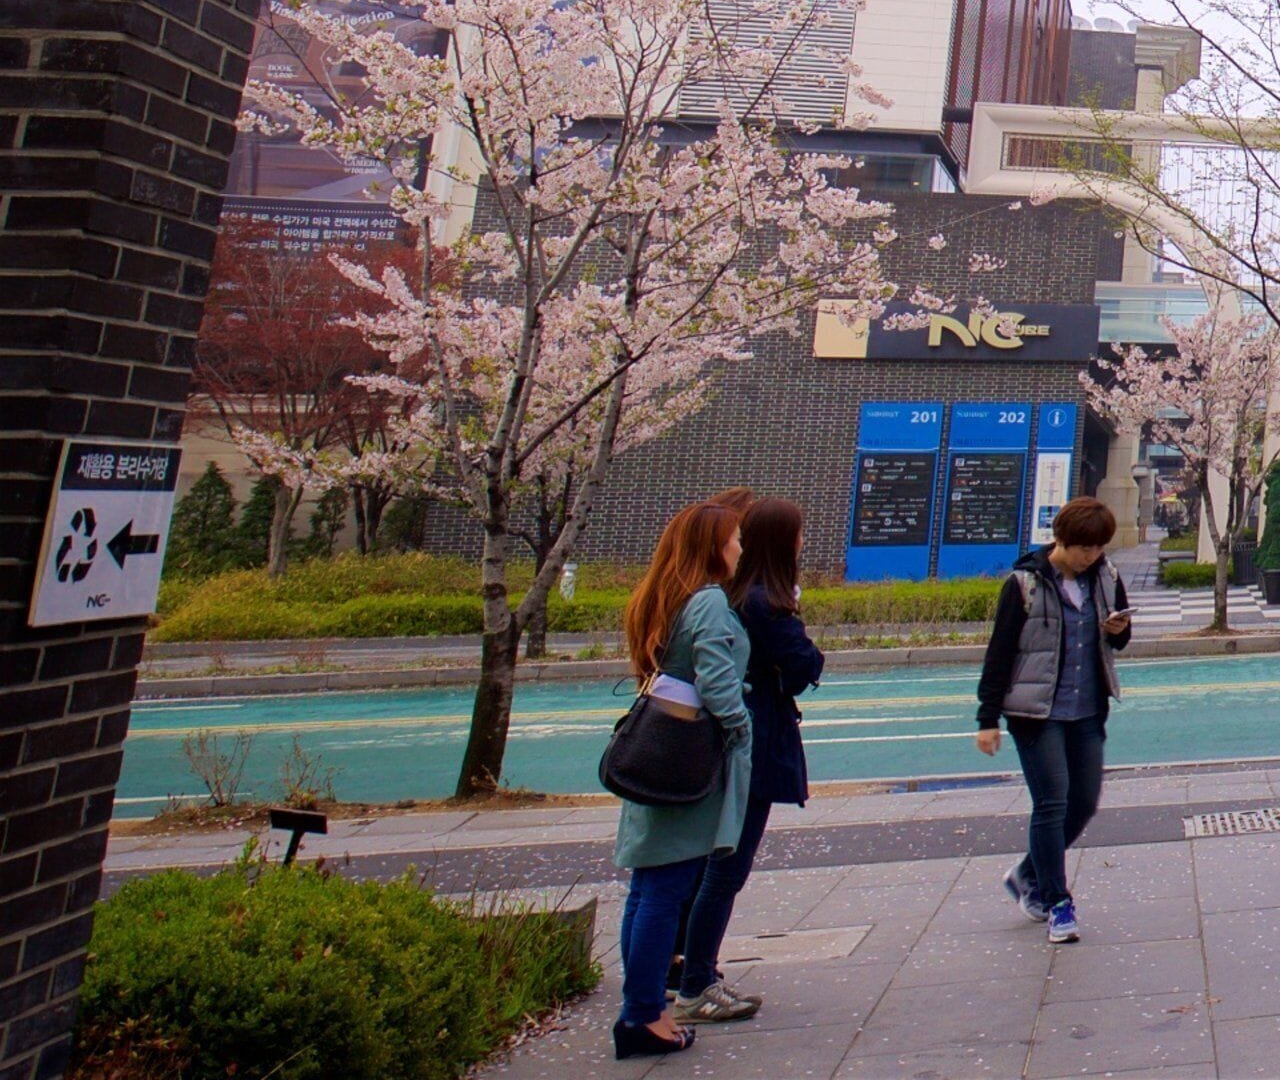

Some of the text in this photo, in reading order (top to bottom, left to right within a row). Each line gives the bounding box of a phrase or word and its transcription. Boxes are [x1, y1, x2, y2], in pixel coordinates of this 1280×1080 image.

[928, 311, 1026, 349] NC
[911, 411, 937, 424] 201
[998, 411, 1025, 424] 202
[77, 453, 169, 481] 재활용 분리수거장
